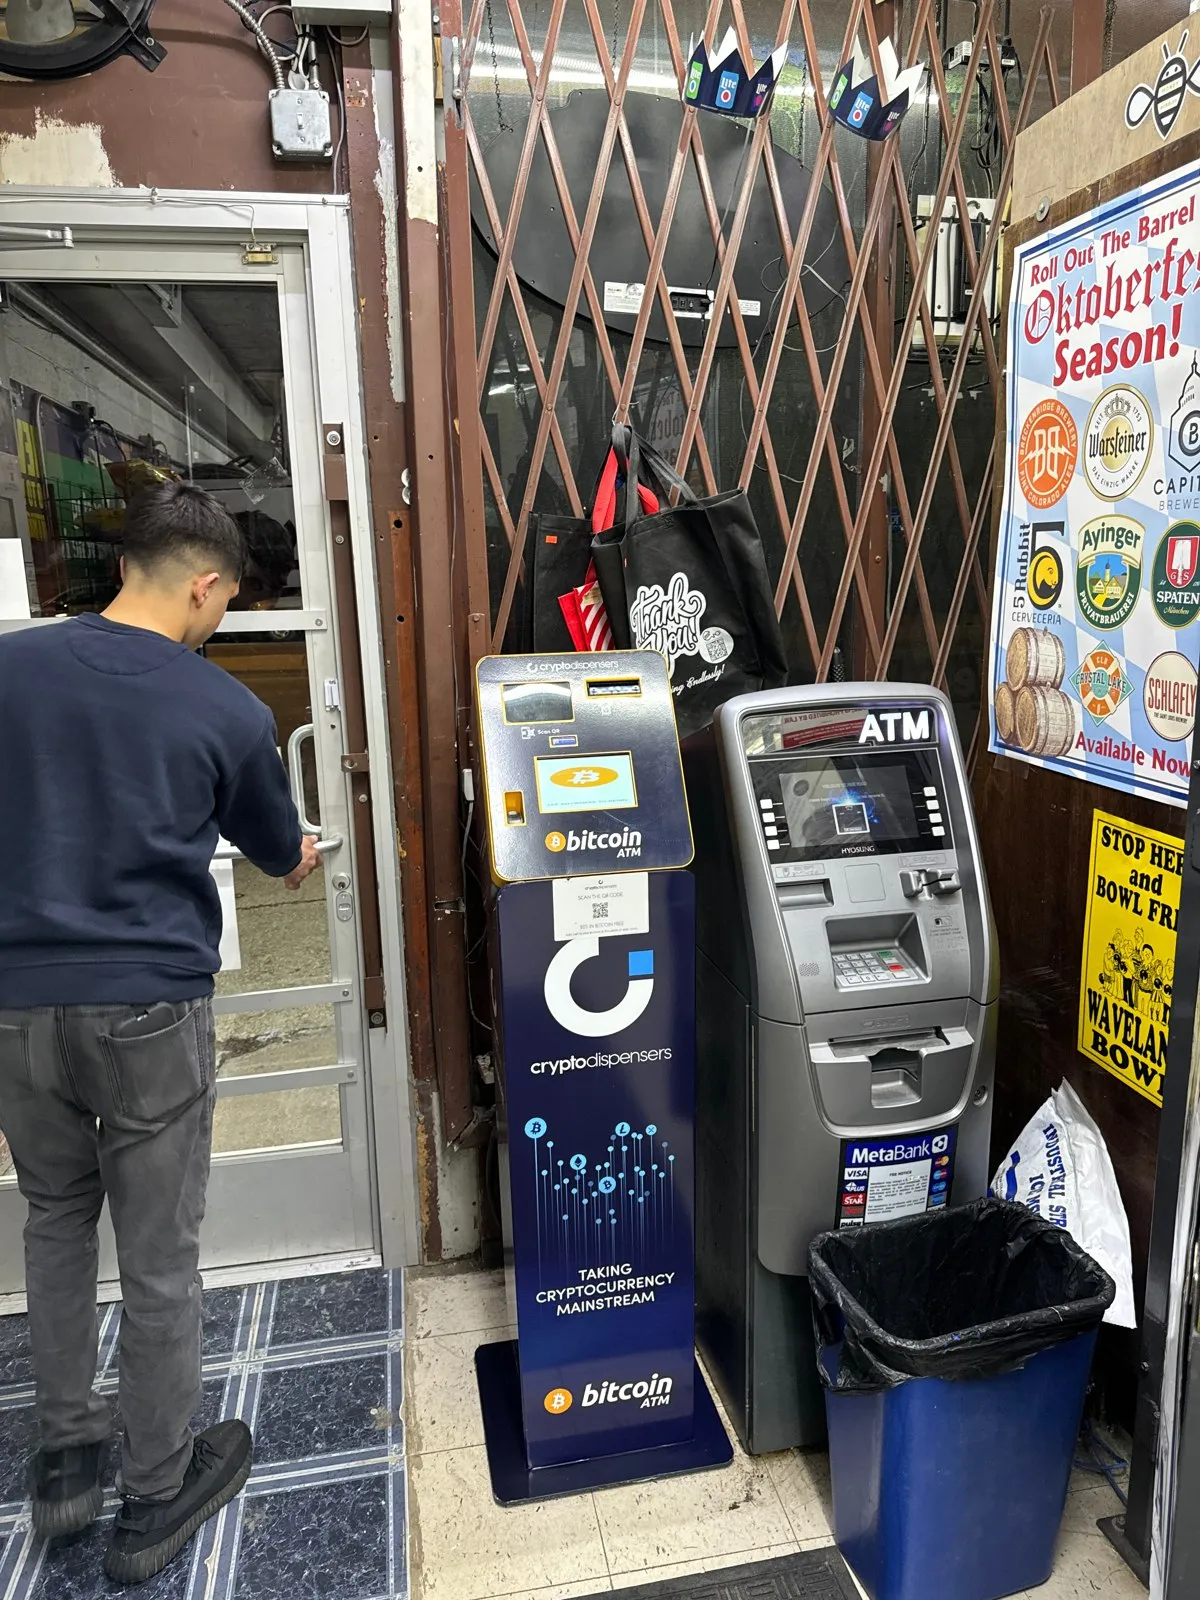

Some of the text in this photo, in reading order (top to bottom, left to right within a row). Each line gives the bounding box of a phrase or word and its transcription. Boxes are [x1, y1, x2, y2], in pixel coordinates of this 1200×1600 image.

[721, 77, 738, 89] Lite
[756, 83, 768, 94] Lite
[855, 97, 871, 111] Lite
[1030, 194, 1196, 287] Roll Out The Barrel
[1053, 303, 1182, 387] Season!
[1020, 402, 1077, 456] BRECKENRIDGE BREWERY
[1089, 427, 1147, 458] Warsteiner
[1028, 490, 1061, 506] COLORADO
[1061, 463, 1074, 490] ALES
[1081, 522, 1141, 551] Ayinger
[1013, 522, 1030, 608] 5 Rabbit
[1079, 590, 1135, 624] PRIVATBRAUEREI
[1156, 590, 1200, 605] SPATEN
[1011, 611, 1062, 626] CERVECERIA
[540, 660, 619, 672] cryptodispensers
[686, 664, 725, 688] Endlessly!
[1075, 671, 1105, 685] CRYSTAL
[1108, 674, 1127, 693] LAKE
[1147, 677, 1197, 717] SCHLAFLY
[858, 710, 930, 743] ATM
[1075, 731, 1190, 777] Available Now
[566, 826, 642, 851] bitcoin
[841, 845, 875, 855] HYOSUNG
[1101, 825, 1145, 859] STOP
[616, 848, 642, 858] ATM
[1096, 875, 1143, 916] BOWL
[1129, 869, 1163, 896] and
[530, 1047, 673, 1076] cryptodispensers
[851, 1139, 931, 1164] MetaBank
[847, 1169, 868, 1178] VISA
[844, 1194, 864, 1205] STAR
[840, 1219, 862, 1228] pulse
[578, 1263, 633, 1282] TAKING
[535, 1272, 675, 1304] CRYPTOCURRENCY
[556, 1290, 655, 1316] MAINSTREAM
[581, 1372, 673, 1408] bitcoin
[640, 1394, 670, 1409] ATM
